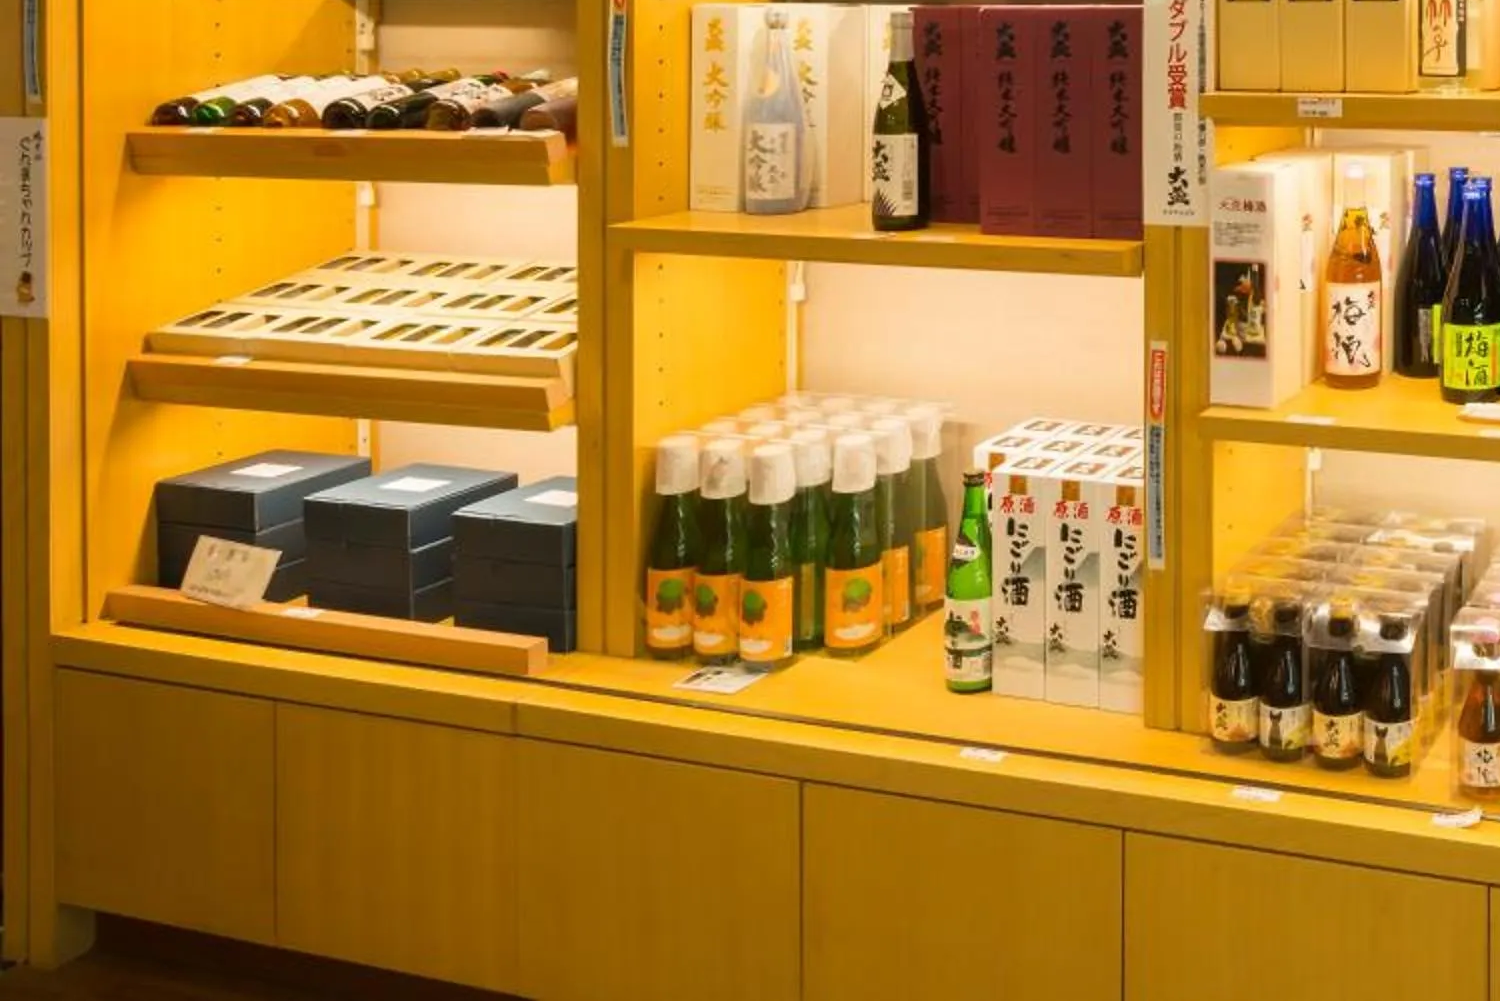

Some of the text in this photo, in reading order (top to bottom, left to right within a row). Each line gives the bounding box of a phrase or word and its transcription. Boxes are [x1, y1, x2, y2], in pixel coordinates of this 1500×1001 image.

[1464, 330, 1490, 387] 梅酒
[1000, 494, 1035, 515] 原酒
[1054, 500, 1089, 520] 原酒
[1106, 505, 1143, 526] 原酒
[1002, 517, 1030, 606] にごり酒
[1054, 522, 1083, 613] にごり酒
[1107, 527, 1139, 620] にごり酒
